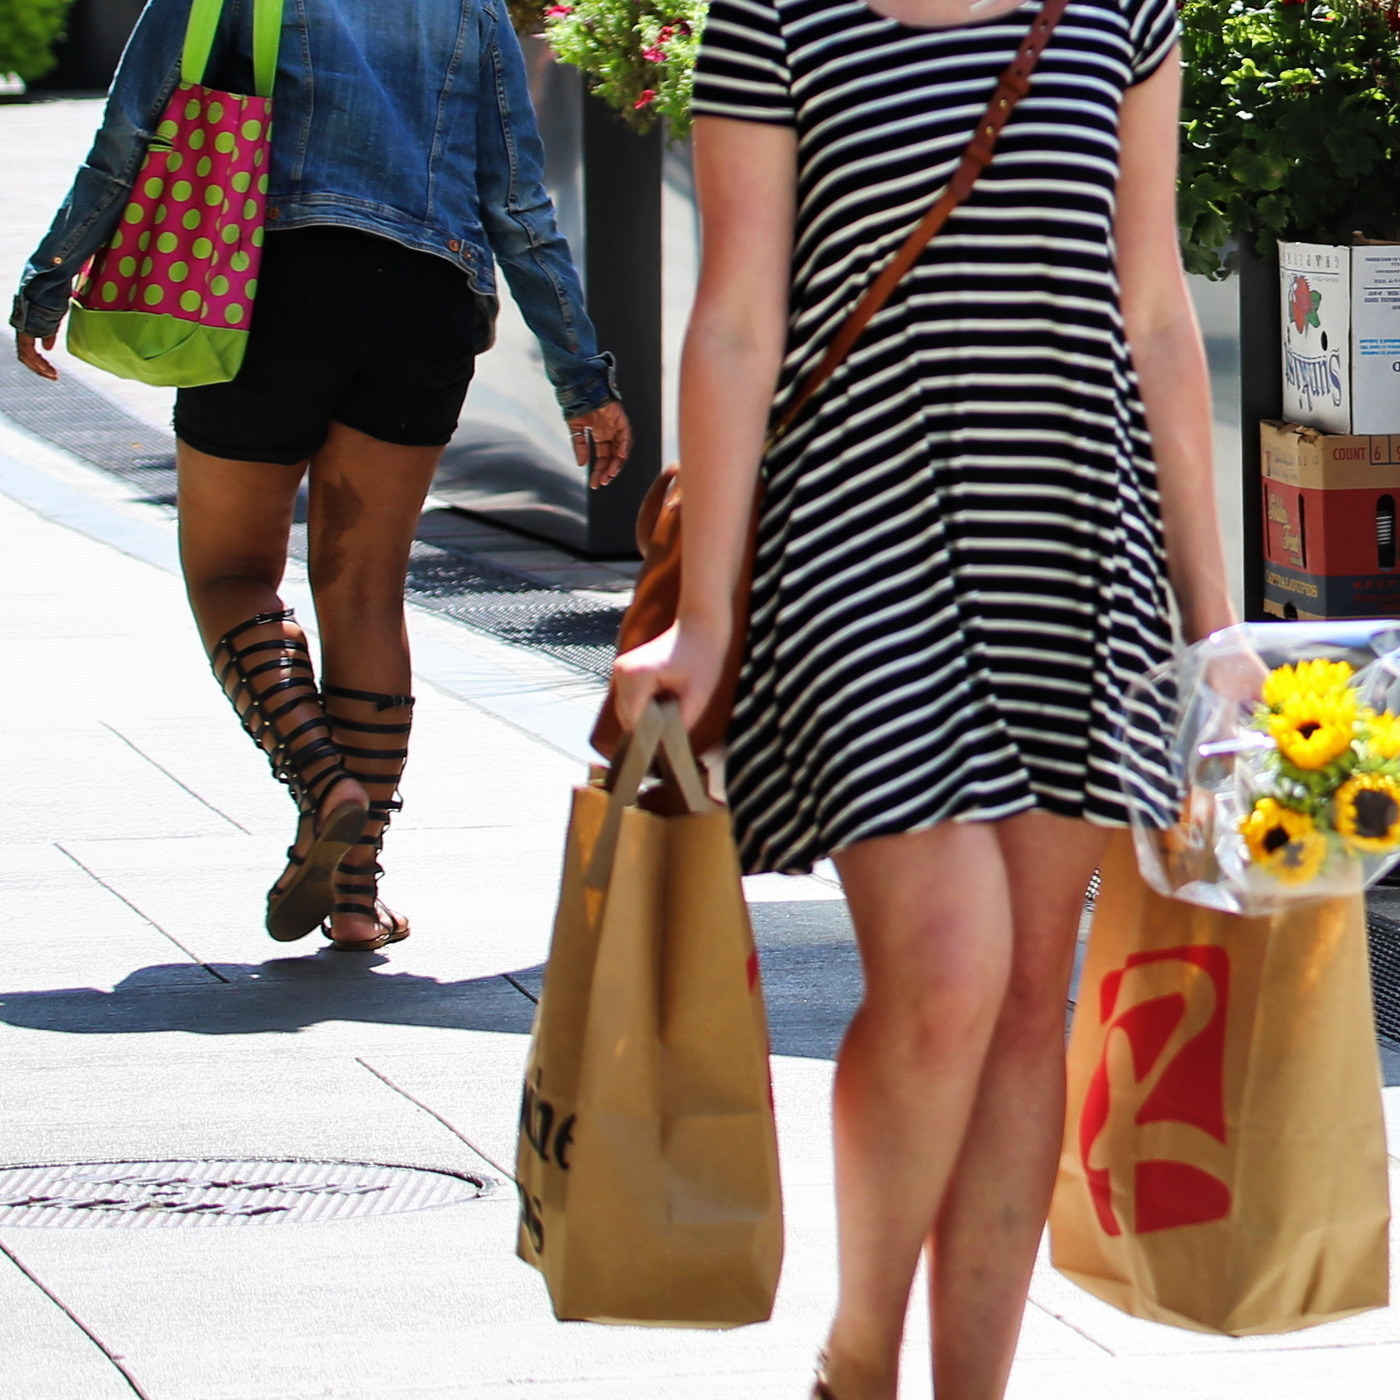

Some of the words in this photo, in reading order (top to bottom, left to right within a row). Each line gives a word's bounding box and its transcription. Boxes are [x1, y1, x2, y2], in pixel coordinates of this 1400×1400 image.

[1332, 447, 1366, 461] COUNT
[1373, 446, 1381, 460] 6
[1353, 578, 1396, 590] KEEP
